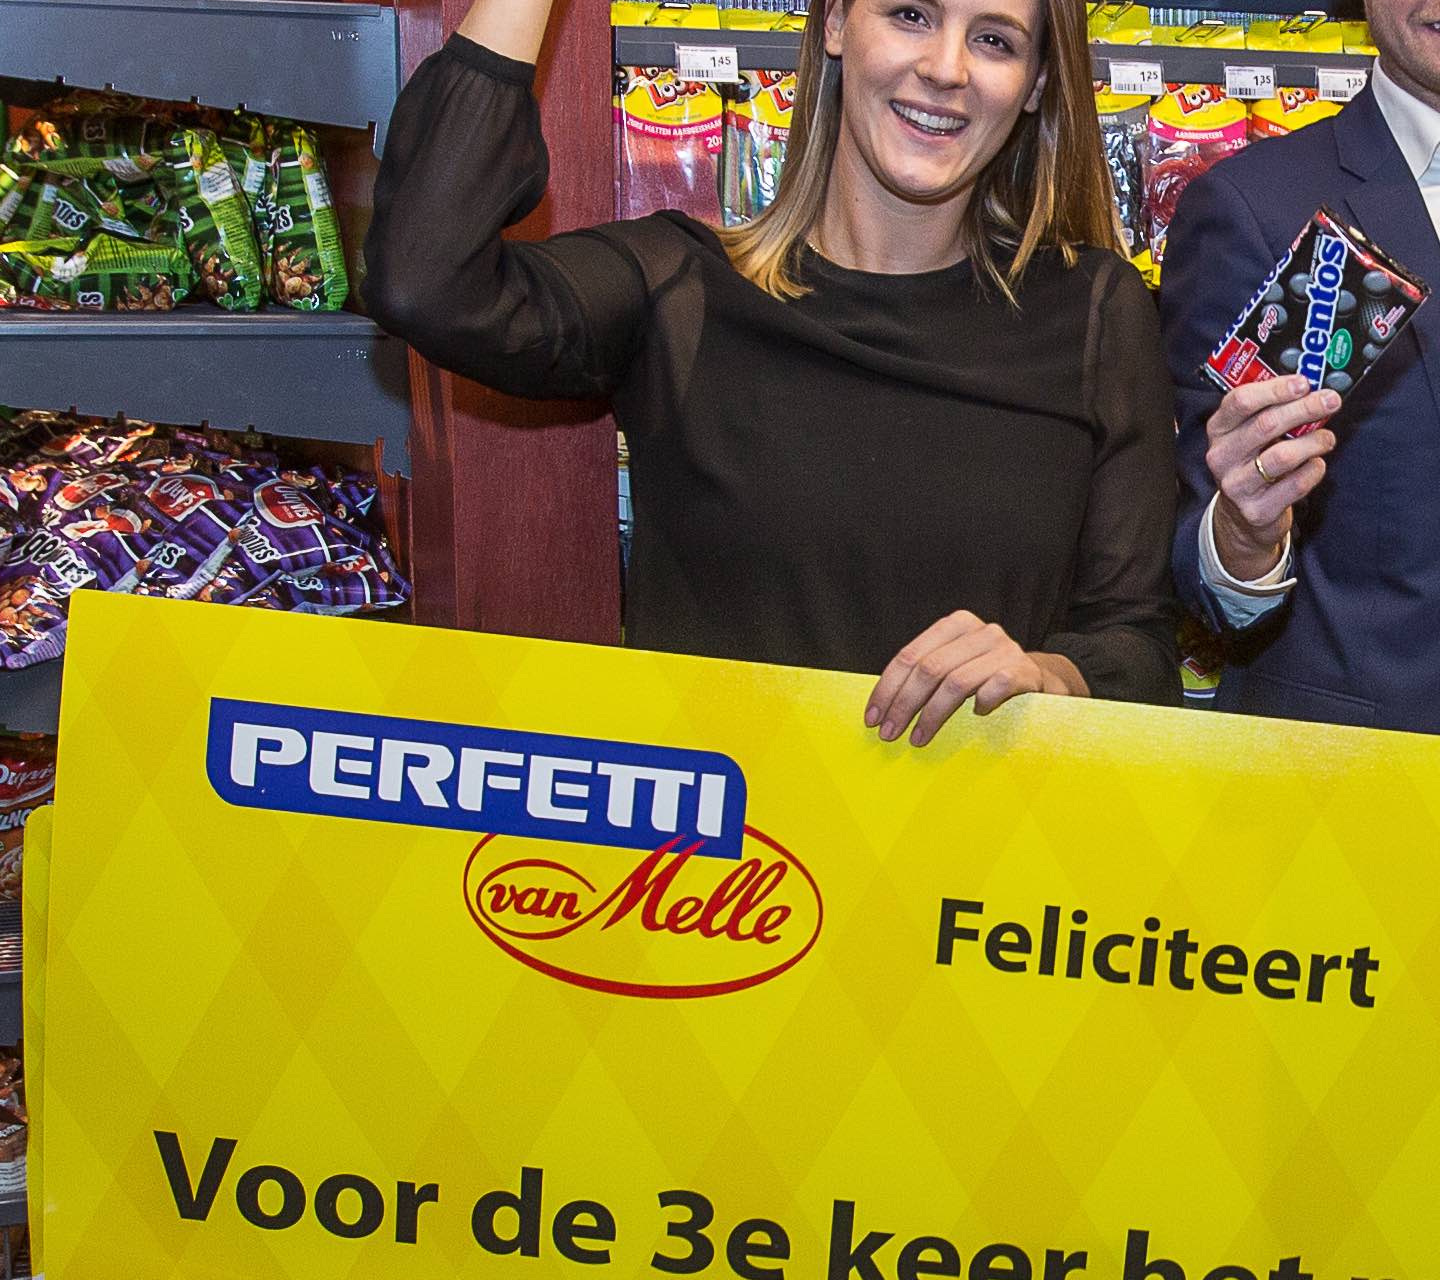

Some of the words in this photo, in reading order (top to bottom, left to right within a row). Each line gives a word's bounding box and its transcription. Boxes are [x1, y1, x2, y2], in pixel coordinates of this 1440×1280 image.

[1296, 232, 1350, 391] mentos
[230, 722, 727, 838] PERFETTI
[487, 884, 583, 918] van
[580, 833, 792, 945] Melle
[936, 897, 1380, 1008] Feliciteert
[154, 1131, 439, 1245] Voor
[471, 1166, 617, 1265] de
